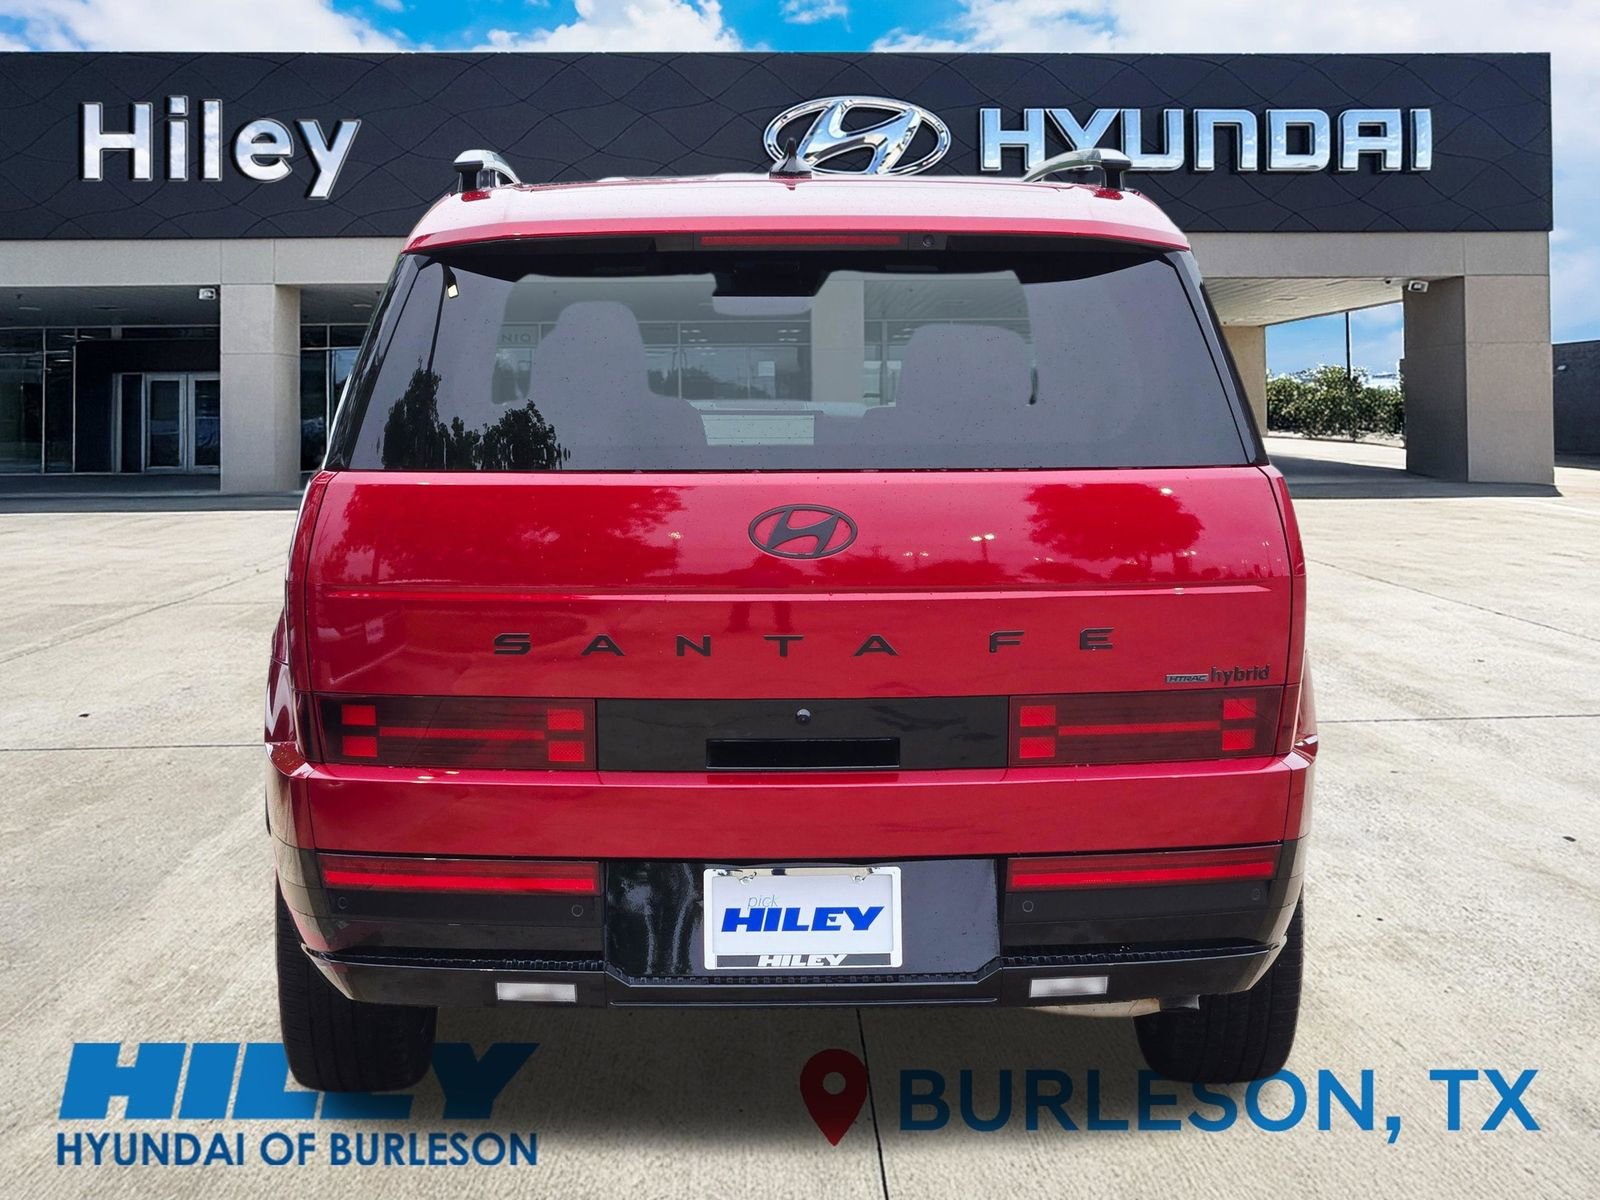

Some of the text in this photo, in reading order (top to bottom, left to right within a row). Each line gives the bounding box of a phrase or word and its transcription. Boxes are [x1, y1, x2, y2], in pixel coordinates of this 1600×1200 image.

[79, 95, 362, 200] Hiley
[978, 107, 1433, 172] HYUNDAI
[492, 627, 1115, 658] SANTA FE
[1210, 664, 1271, 686] hybrid
[747, 894, 779, 909] pick
[721, 906, 885, 933] HILEY
[757, 954, 848, 967] HILEY
